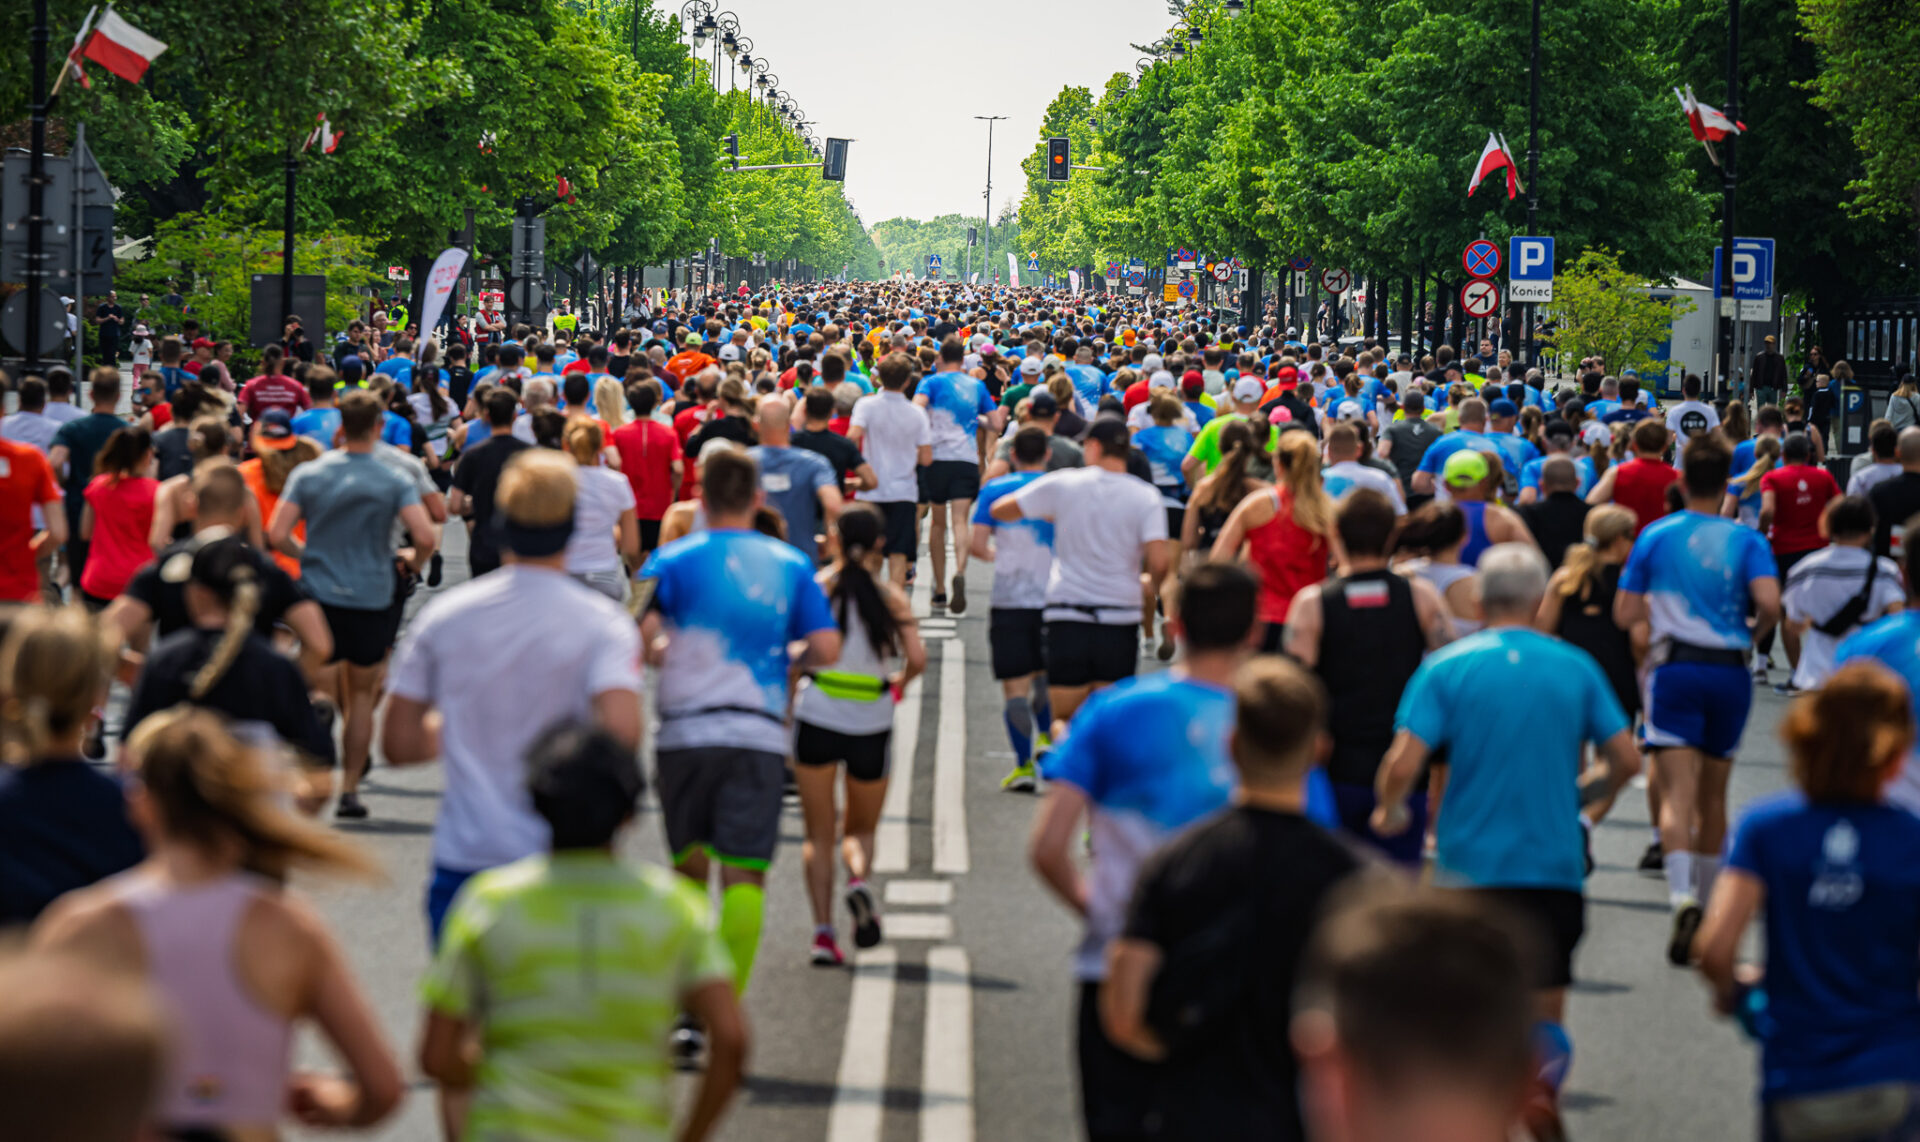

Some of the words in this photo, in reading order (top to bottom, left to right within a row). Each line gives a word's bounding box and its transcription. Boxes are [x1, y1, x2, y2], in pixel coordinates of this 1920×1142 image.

[1520, 241, 1545, 275] P
[1511, 285, 1550, 297] Koniec
[1849, 393, 1860, 409] P
